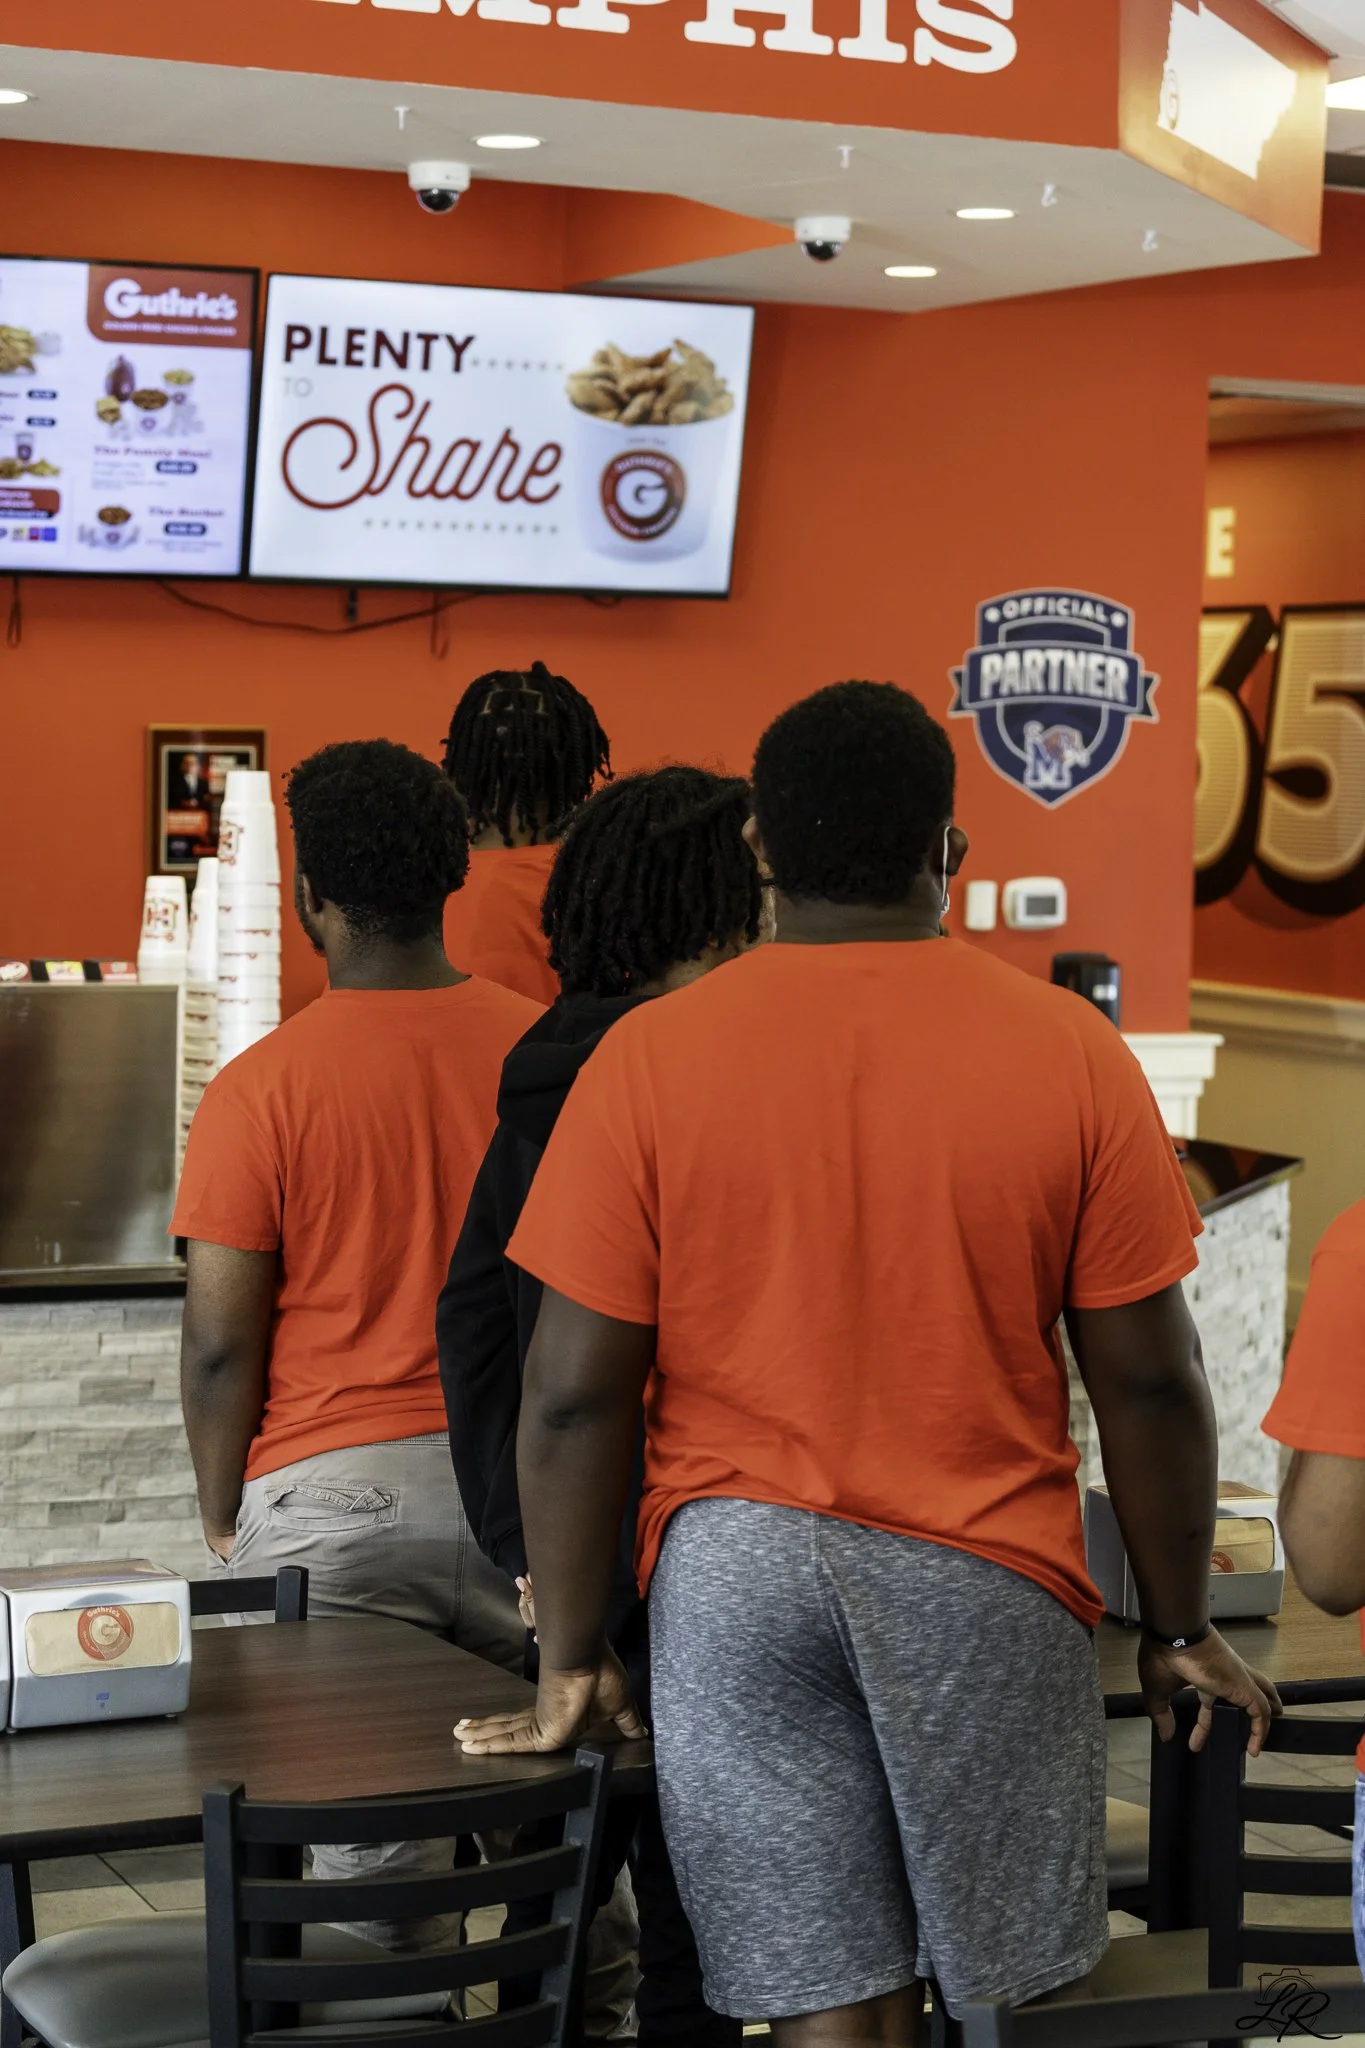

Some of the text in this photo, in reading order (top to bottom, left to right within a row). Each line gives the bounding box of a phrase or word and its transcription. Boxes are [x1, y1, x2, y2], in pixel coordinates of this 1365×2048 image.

[284, 324, 476, 373] PLENTY
[283, 376, 314, 398] TO
[281, 382, 564, 511] Share
[1001, 596, 1109, 624] OFFICIAL
[979, 647, 1129, 703] PARTNER
